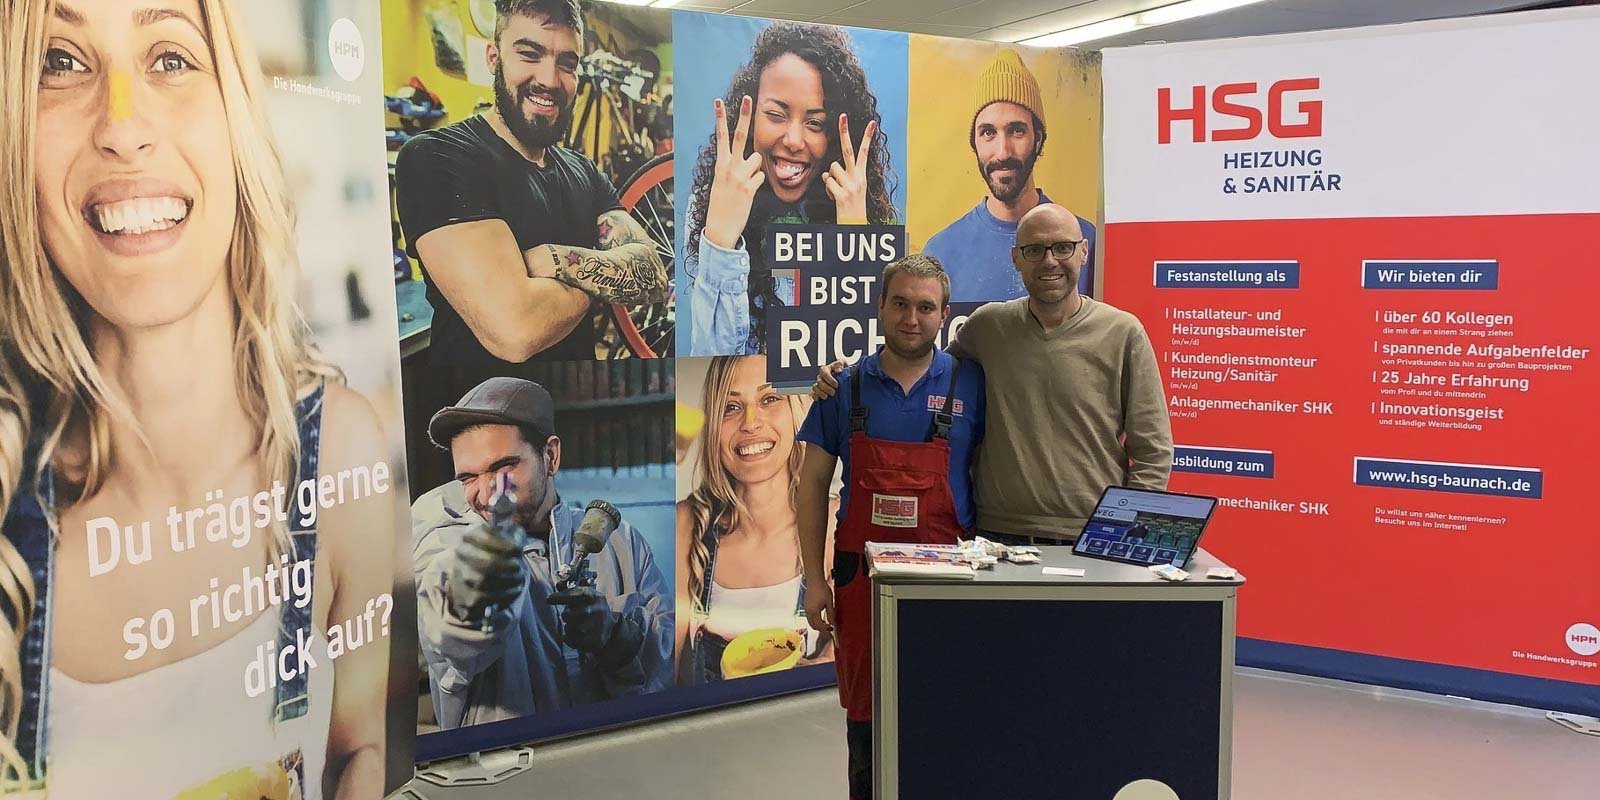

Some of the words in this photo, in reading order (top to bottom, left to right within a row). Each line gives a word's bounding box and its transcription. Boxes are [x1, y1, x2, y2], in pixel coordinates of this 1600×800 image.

[334, 41, 360, 58] HPM
[274, 76, 288, 90] Die
[1158, 78, 1322, 144] HSG
[1224, 150, 1322, 170] HEIZUNG
[1223, 178, 1236, 194] &
[1244, 170, 1342, 194] SANITÄR
[775, 232, 822, 262] BEI
[837, 232, 896, 262] UNS
[1167, 270, 1262, 284] Festanstellung
[1266, 270, 1286, 282] als
[1378, 270, 1404, 282] Wir
[1409, 270, 1456, 282] bieten
[1460, 270, 1482, 282] dir
[810, 276, 876, 305] BIST
[1173, 308, 1252, 320] Installateur-
[1256, 309, 1281, 320] und
[1384, 311, 1417, 323] über
[1422, 311, 1441, 324] 60
[1446, 312, 1514, 327] Kollegen
[1172, 324, 1306, 338] Heizungsbaumeister
[1434, 328, 1458, 336] einem
[1459, 328, 1485, 337] Strang
[1172, 338, 1200, 346] (m/w/d)
[1382, 342, 1462, 357] spannende
[1466, 344, 1590, 360] Aufgabenfelder
[1172, 352, 1318, 367] Kundendienstmonteur
[1397, 358, 1447, 367] Privatkunden
[1462, 360, 1476, 368] hin
[1488, 361, 1516, 370] großen
[1518, 362, 1572, 371] Bauprojekten
[1171, 368, 1278, 382] Heizung/Sanitär
[1381, 371, 1400, 384] 25
[1404, 372, 1446, 386] Jahre
[1451, 374, 1530, 391] Erfahrung
[1170, 382, 1198, 390] (m/w/d)
[1398, 388, 1416, 396] Profi
[1446, 390, 1486, 398] mittendrin
[1170, 396, 1298, 412] Anlagenmechaniker
[1303, 402, 1334, 414] SHK
[1380, 401, 1504, 422] Innovationsgeist
[1170, 410, 1198, 418] (m/w/d)
[1379, 418, 1392, 426] und
[1395, 419, 1426, 428] ständige
[1428, 420, 1482, 430] Weiterbildung
[1171, 456, 1233, 472] usbildung
[1236, 460, 1264, 472] zum
[1369, 470, 1531, 492] www.hsg-baunach.de
[874, 498, 914, 516] HSG
[1300, 502, 1328, 514] SHK
[86, 516, 152, 578] Du
[166, 480, 287, 552] trägst
[298, 460, 390, 528] gerne
[1375, 517, 1406, 526] Besuche
[1422, 520, 1432, 528] im
[1434, 522, 1468, 531] Internet!
[1425, 511, 1447, 520] näher
[1449, 513, 1506, 524] kennenlernen?
[122, 608, 174, 660] so
[189, 554, 312, 638] richtig
[244, 627, 318, 698] dick
[326, 593, 394, 660] auf?
[1572, 634, 1597, 644] HPM
[1512, 650, 1525, 658] Die
[1526, 652, 1598, 668] Handwerksgruppe
